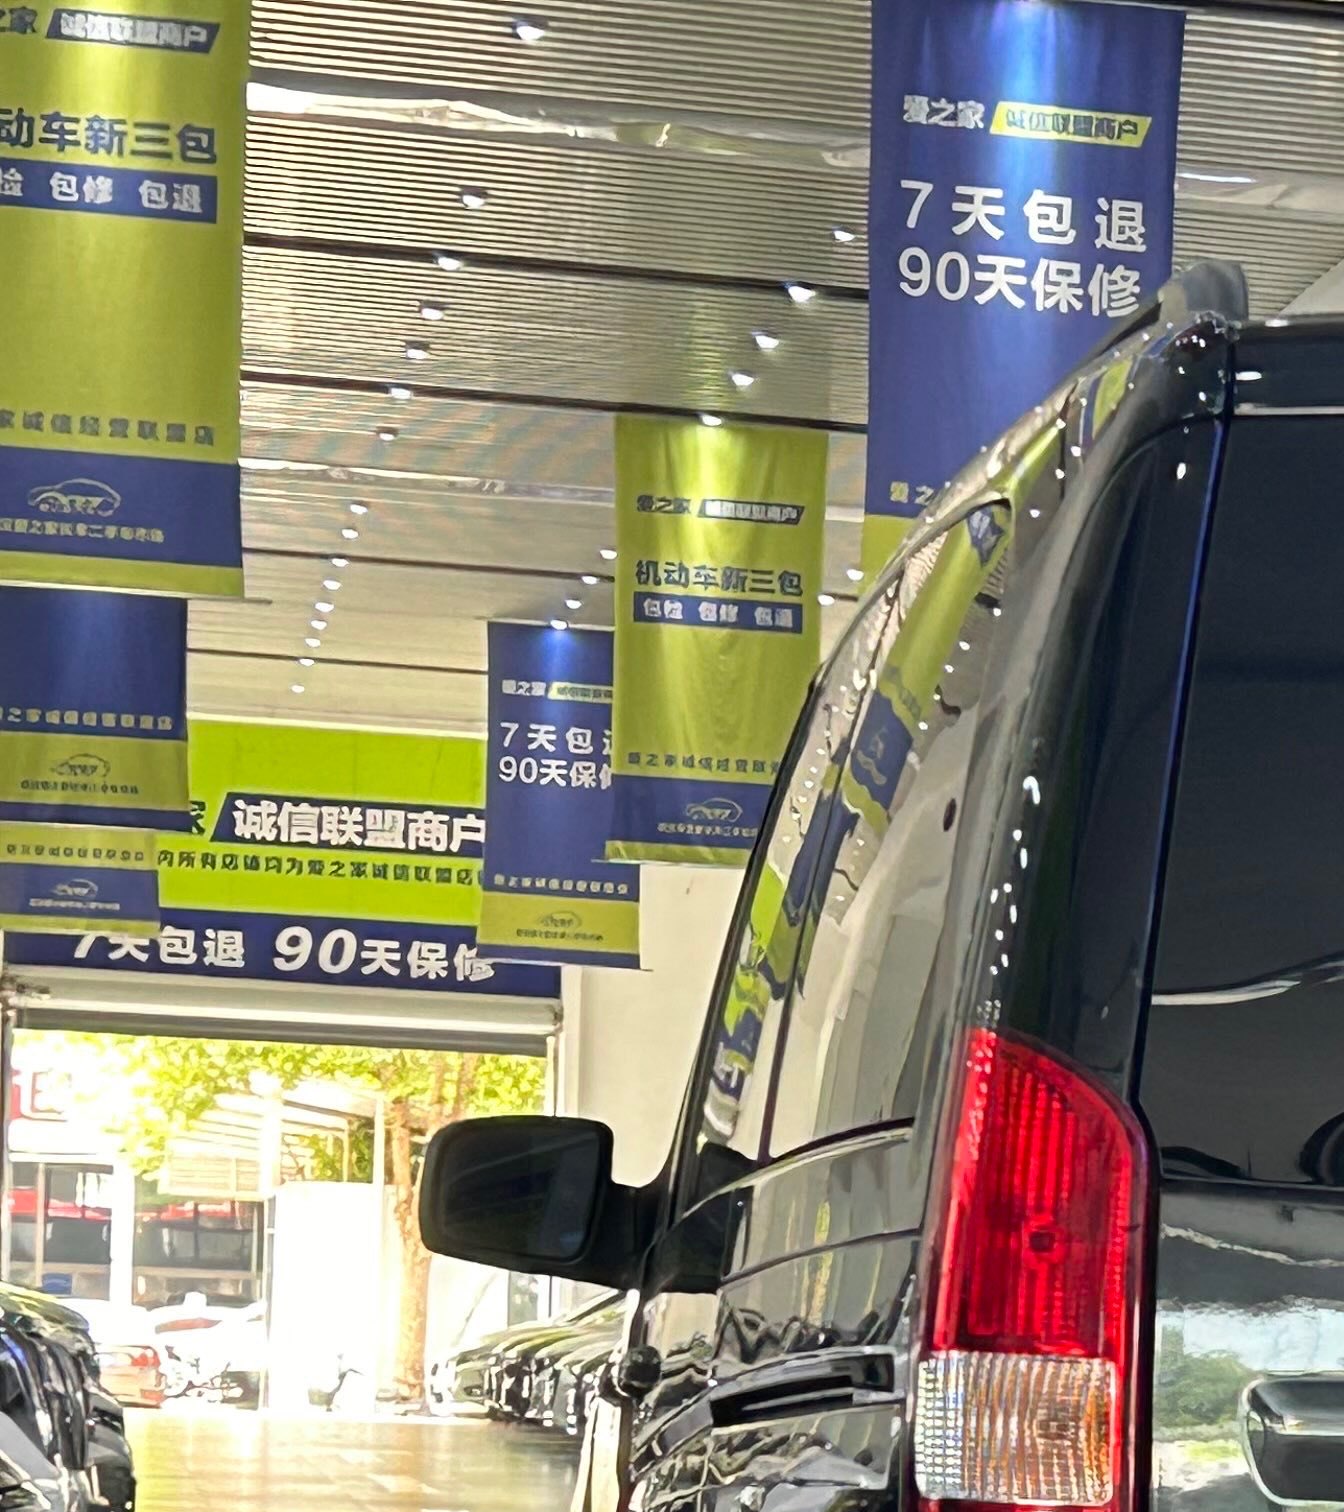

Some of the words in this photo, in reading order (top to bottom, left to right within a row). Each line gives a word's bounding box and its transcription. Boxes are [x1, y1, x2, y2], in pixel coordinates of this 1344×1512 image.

[0, 107, 217, 164] 动车新三包
[900, 179, 1148, 253] 7天包退
[898, 246, 1142, 318] 90天保修
[635, 559, 803, 597] 机动车新三包
[232, 799, 486, 852] 诚信联盟商户
[272, 925, 495, 983] 90天保修
